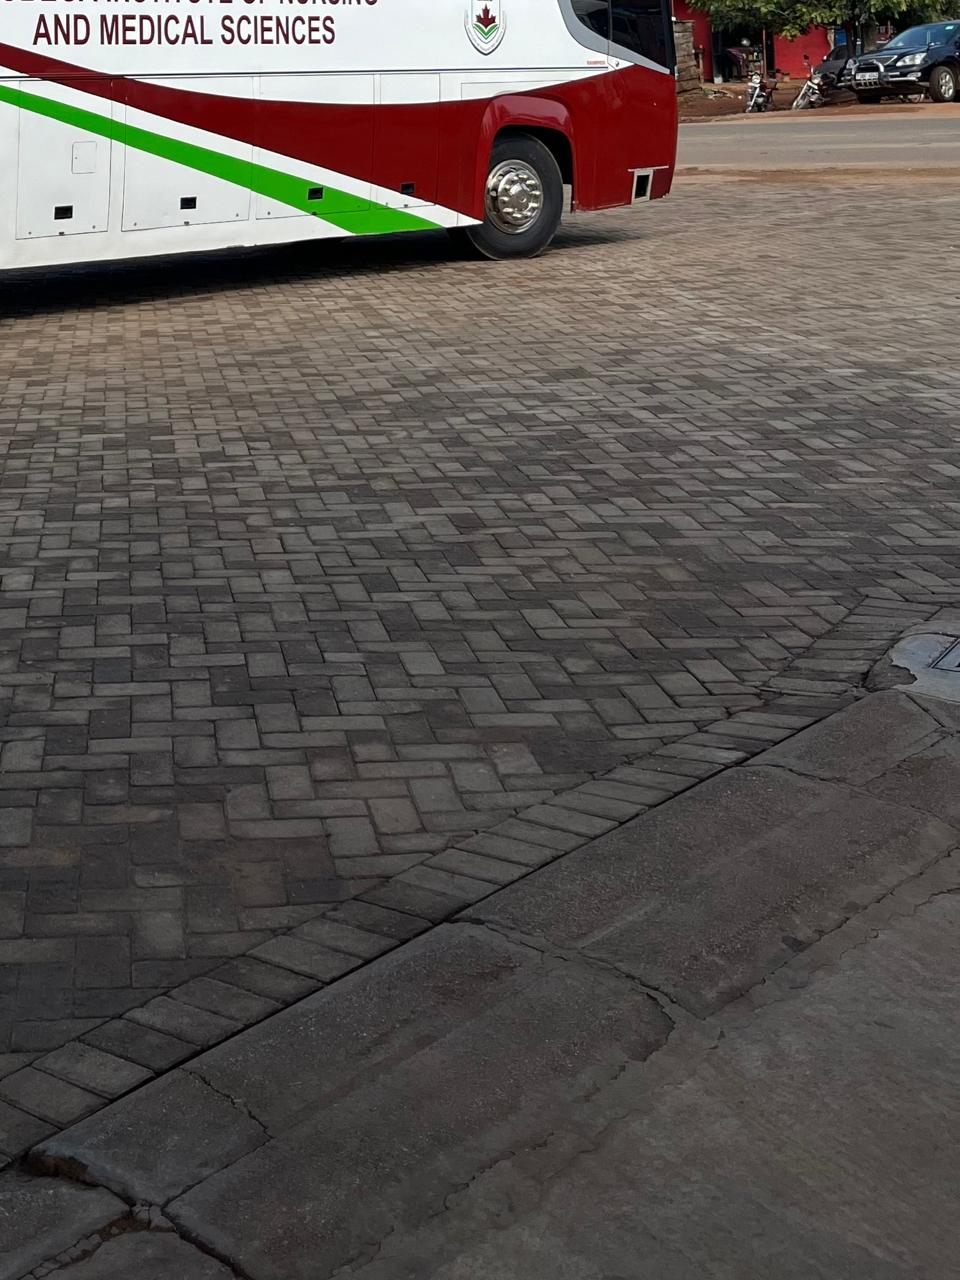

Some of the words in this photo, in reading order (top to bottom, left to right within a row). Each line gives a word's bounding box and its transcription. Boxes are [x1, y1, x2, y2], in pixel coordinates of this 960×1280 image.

[32, 13, 91, 46] AND
[99, 14, 214, 46] MEDICAL
[220, 14, 336, 45] SCIENCES
